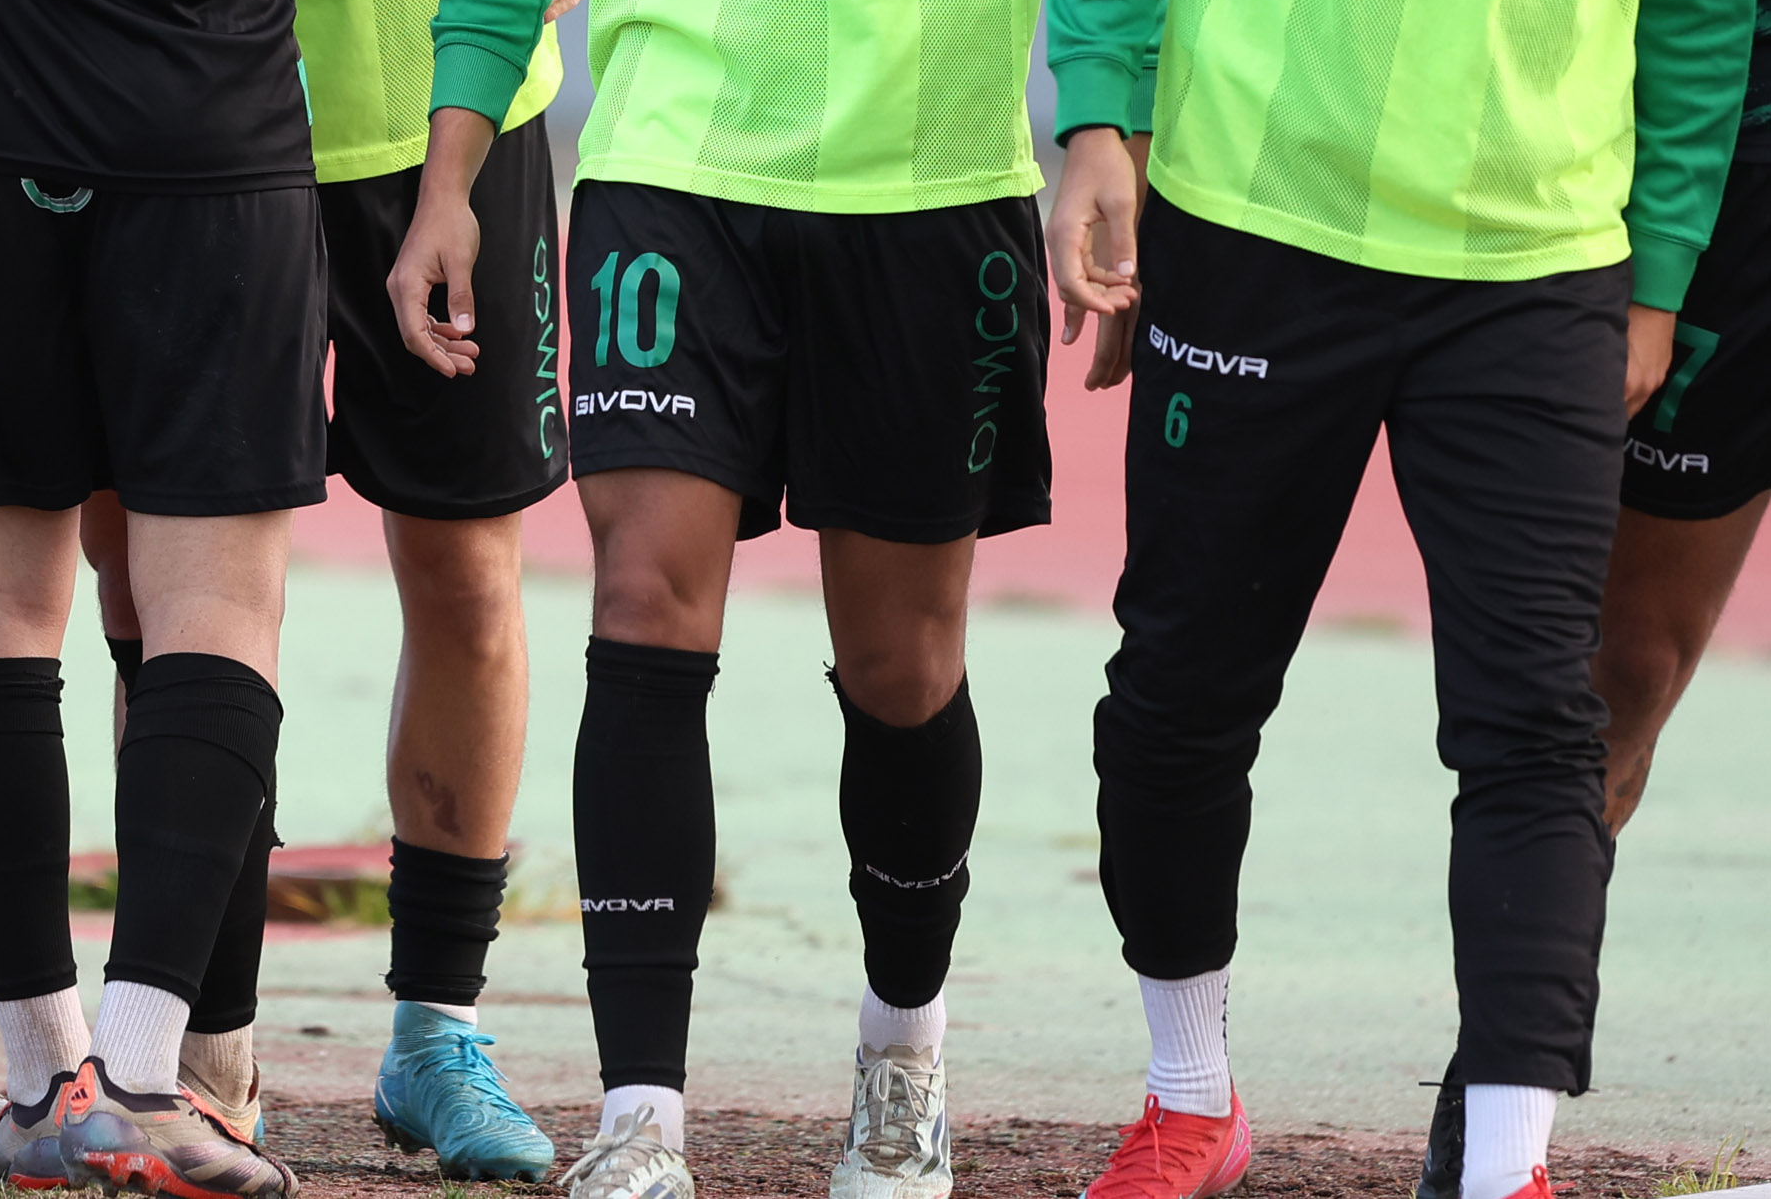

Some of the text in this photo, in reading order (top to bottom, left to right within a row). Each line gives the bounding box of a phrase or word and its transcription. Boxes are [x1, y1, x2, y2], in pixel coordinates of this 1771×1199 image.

[591, 251, 682, 369] 10
[967, 250, 1020, 475] DIMCO
[1149, 323, 1269, 380] GIVOVA
[575, 389, 696, 419] GIVOVA
[1164, 391, 1193, 449] 6
[1623, 437, 1710, 474] OVA
